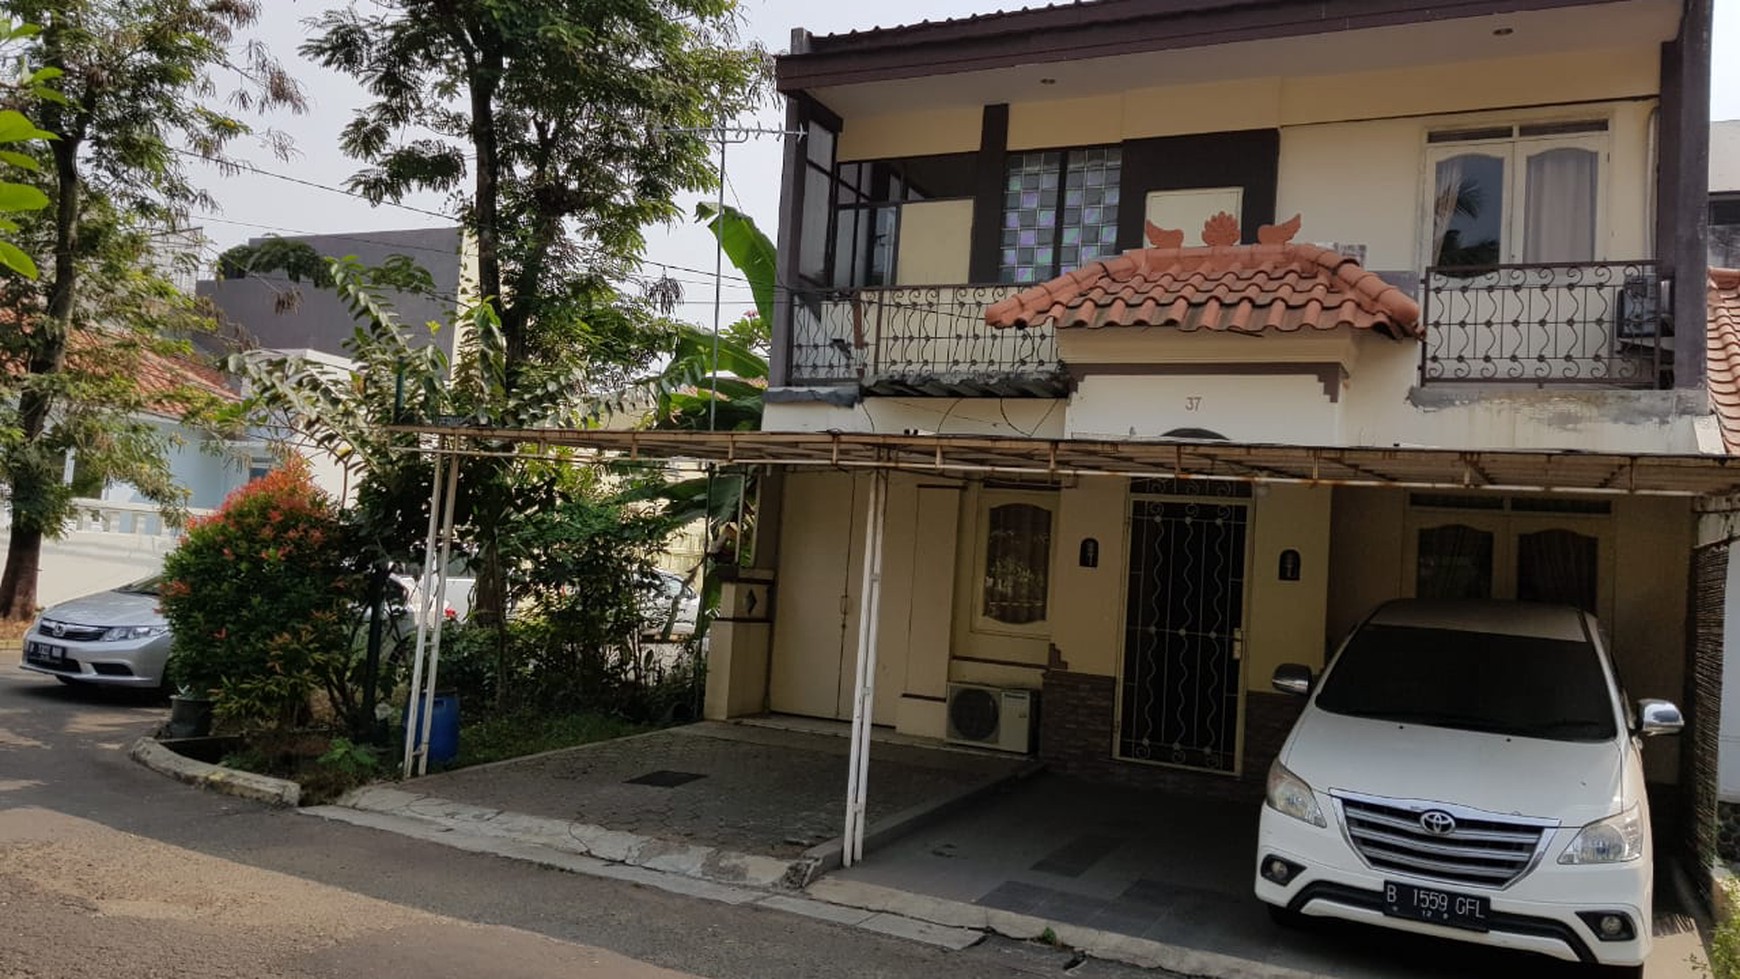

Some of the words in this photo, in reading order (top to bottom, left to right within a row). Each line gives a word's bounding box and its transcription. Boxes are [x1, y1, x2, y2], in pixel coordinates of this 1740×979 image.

[1185, 396, 1202, 411] 37
[1387, 885, 1397, 903] B
[1413, 889, 1448, 911] 1559
